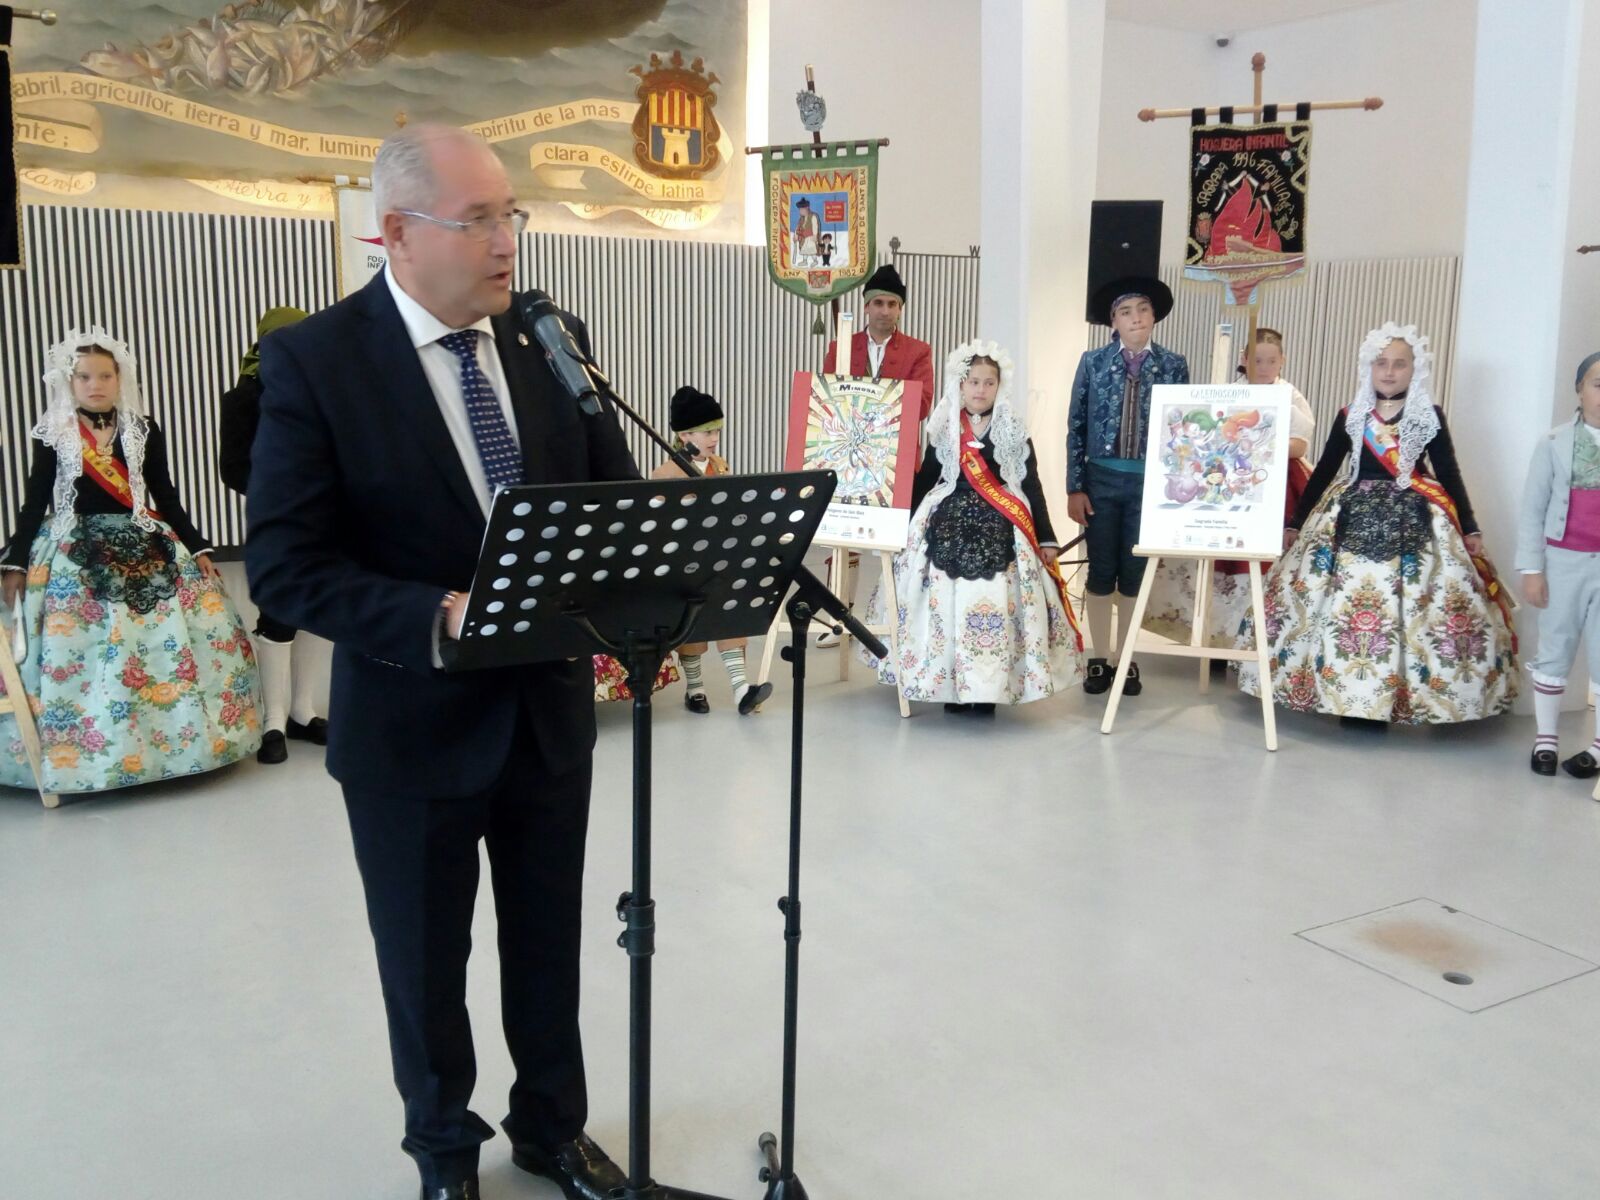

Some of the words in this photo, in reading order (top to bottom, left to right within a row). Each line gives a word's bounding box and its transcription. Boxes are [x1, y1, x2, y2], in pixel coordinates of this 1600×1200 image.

[70, 79, 173, 116] agricultor,
[184, 103, 240, 132] tierra
[250, 123, 261, 140] y
[533, 112, 553, 127] de
[559, 106, 575, 121] la
[582, 104, 620, 119] mas
[1200, 138, 1244, 152] HOGUERA
[1245, 133, 1288, 150] INFANTIL
[1232, 152, 1256, 168] 1996
[544, 145, 589, 162] clara
[600, 153, 654, 194] estirpe
[661, 183, 704, 199] latina
